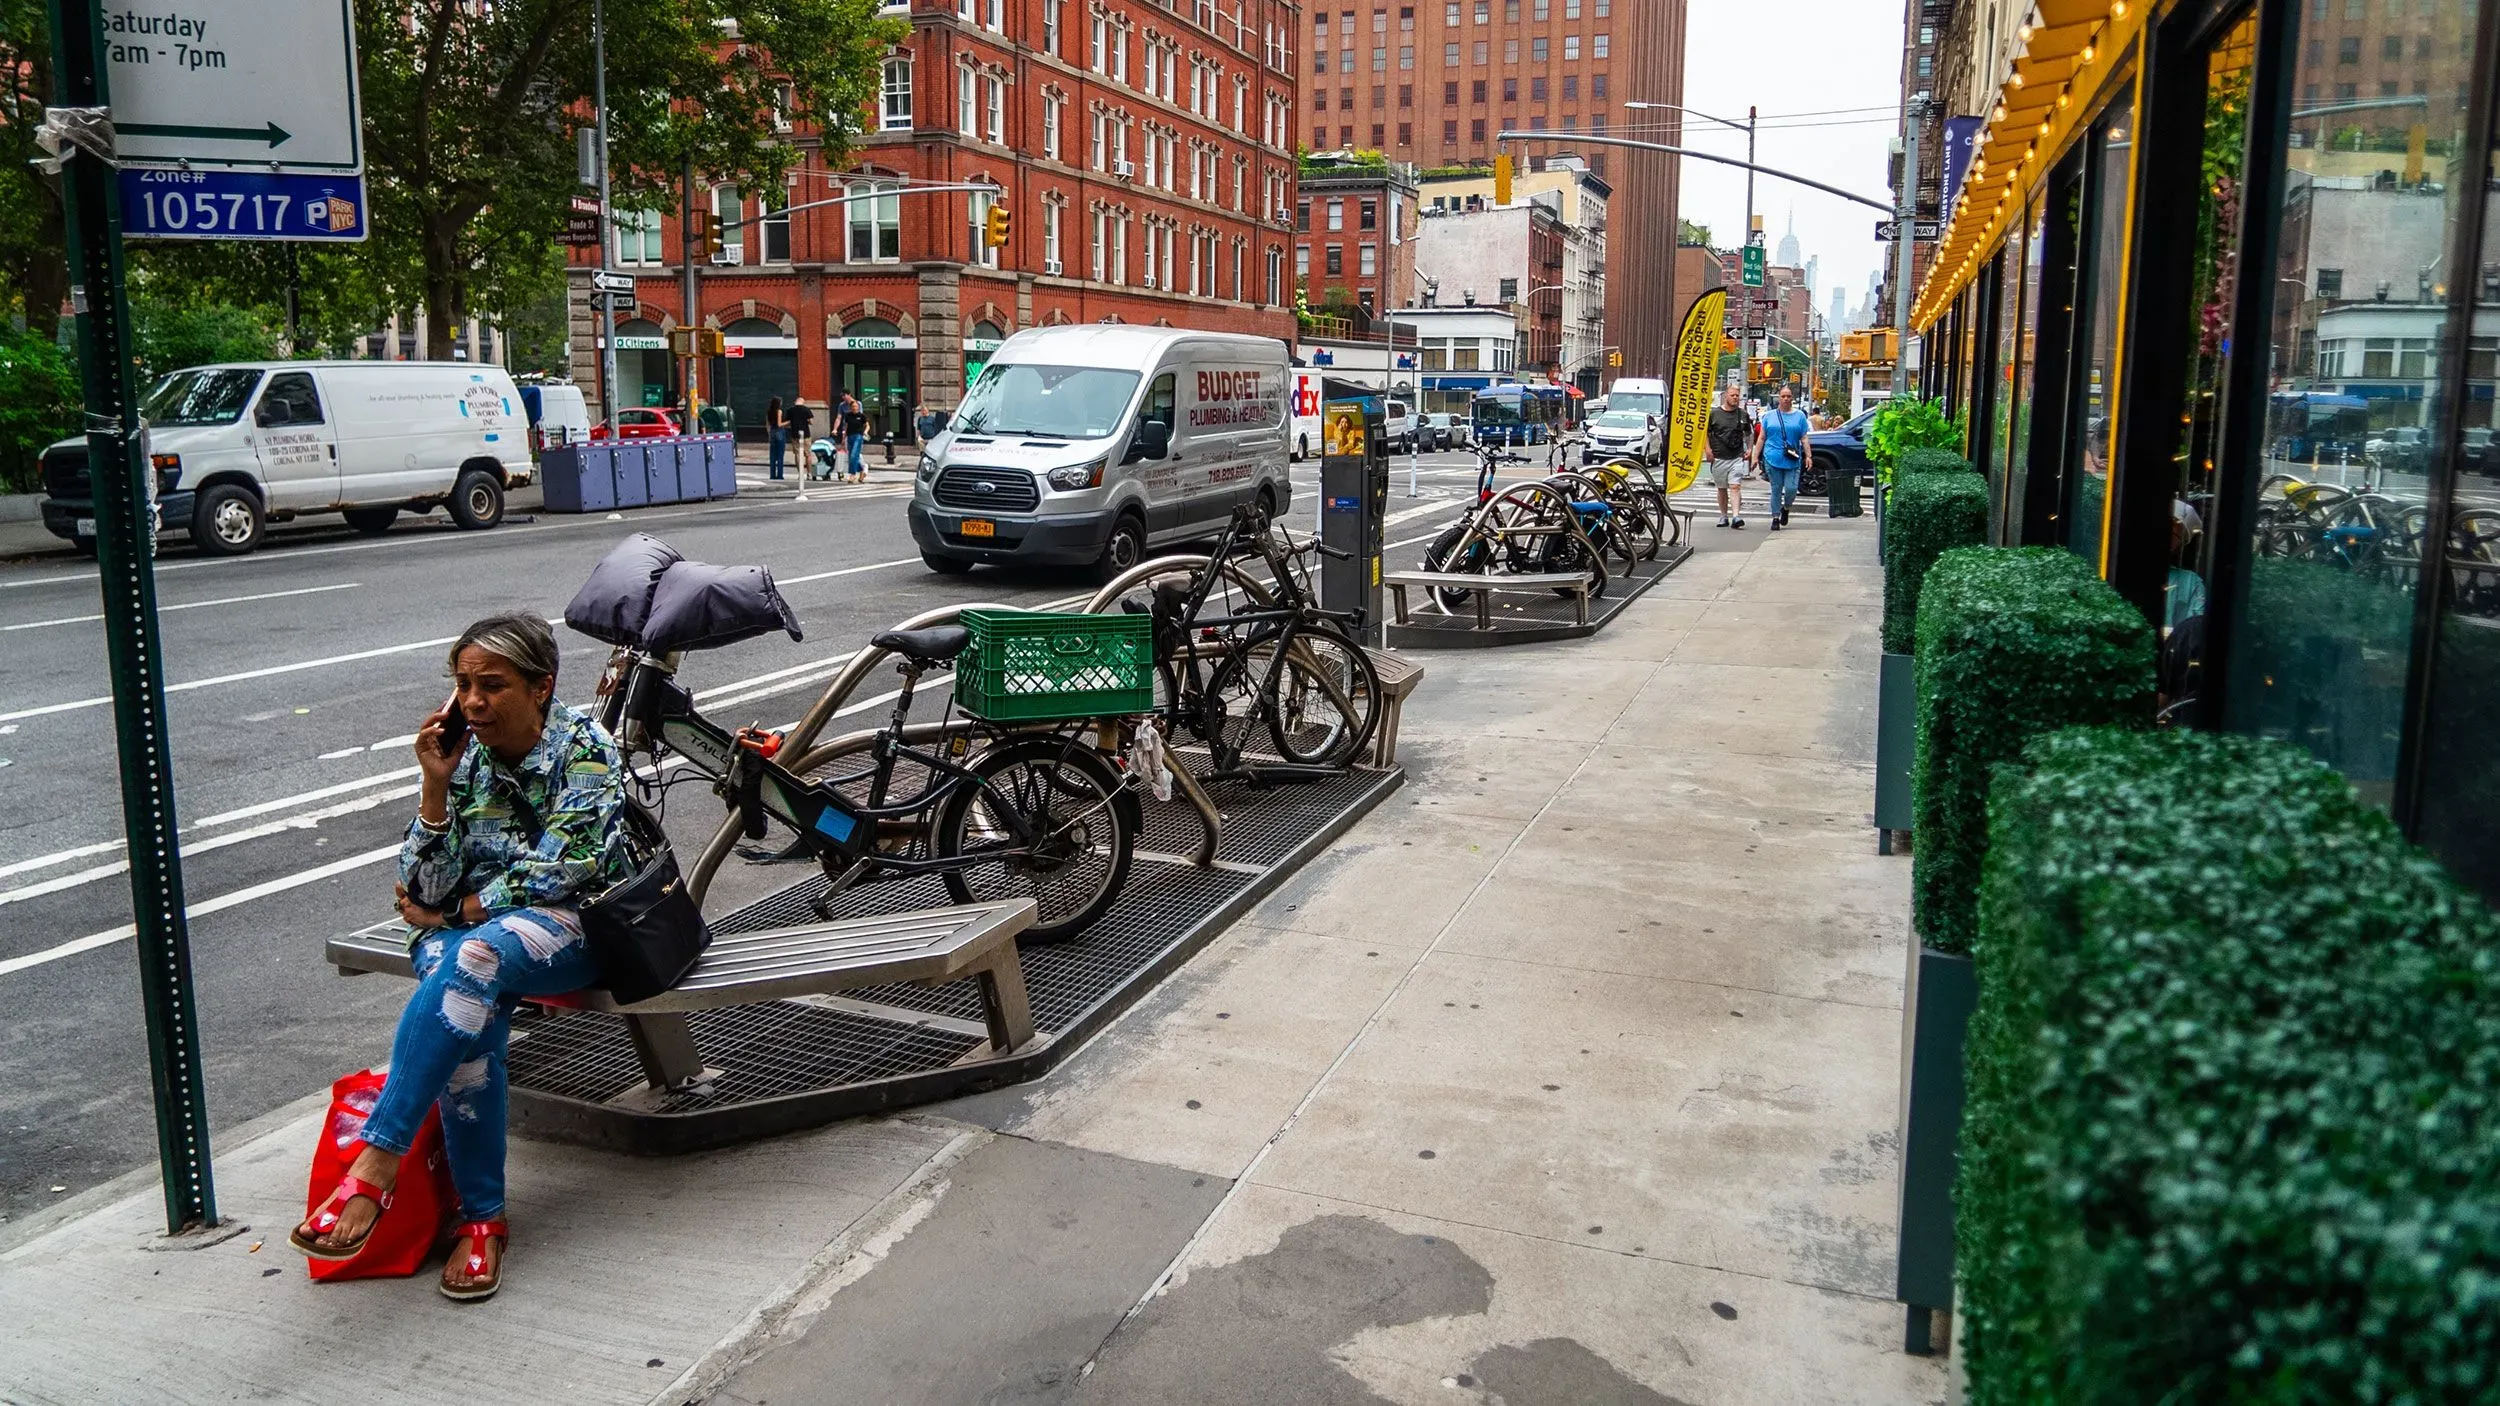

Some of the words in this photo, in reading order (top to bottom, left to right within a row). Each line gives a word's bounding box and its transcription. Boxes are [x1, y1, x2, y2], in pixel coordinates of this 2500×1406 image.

[174, 44, 227, 71] 7pm
[1944, 145, 1952, 172] LANE
[140, 170, 206, 184] Zone#
[331, 200, 353, 214] PARK
[578, 199, 599, 215] Broadway
[1941, 173, 1950, 228] BLUESTONE
[143, 191, 292, 231] 105717
[307, 201, 328, 226] P
[332, 213, 354, 229] NYC
[1914, 227, 1934, 235] WAY
[597, 278, 610, 286] ONE
[616, 298, 632, 306] WAY
[625, 338, 660, 348] Citizens
[857, 339, 896, 349] Citizens
[1705, 330, 1714, 345] us
[1692, 346, 1702, 358] IS
[1702, 348, 1713, 371] join
[1690, 361, 1701, 390] NOW
[1701, 372, 1711, 395] and
[464, 386, 478, 399] NEW
[479, 384, 499, 398] YORK
[1197, 371, 1261, 402] BUDGET
[467, 400, 501, 409] PLUMBING
[1676, 375, 1690, 426] Serafina
[475, 410, 500, 418] WORKS
[1189, 408, 1231, 426] PLUMBING
[1231, 407, 1239, 421] &
[1239, 405, 1267, 422] HEATING
[1683, 393, 1698, 450] ROOFTOP
[1698, 397, 1708, 431] come
